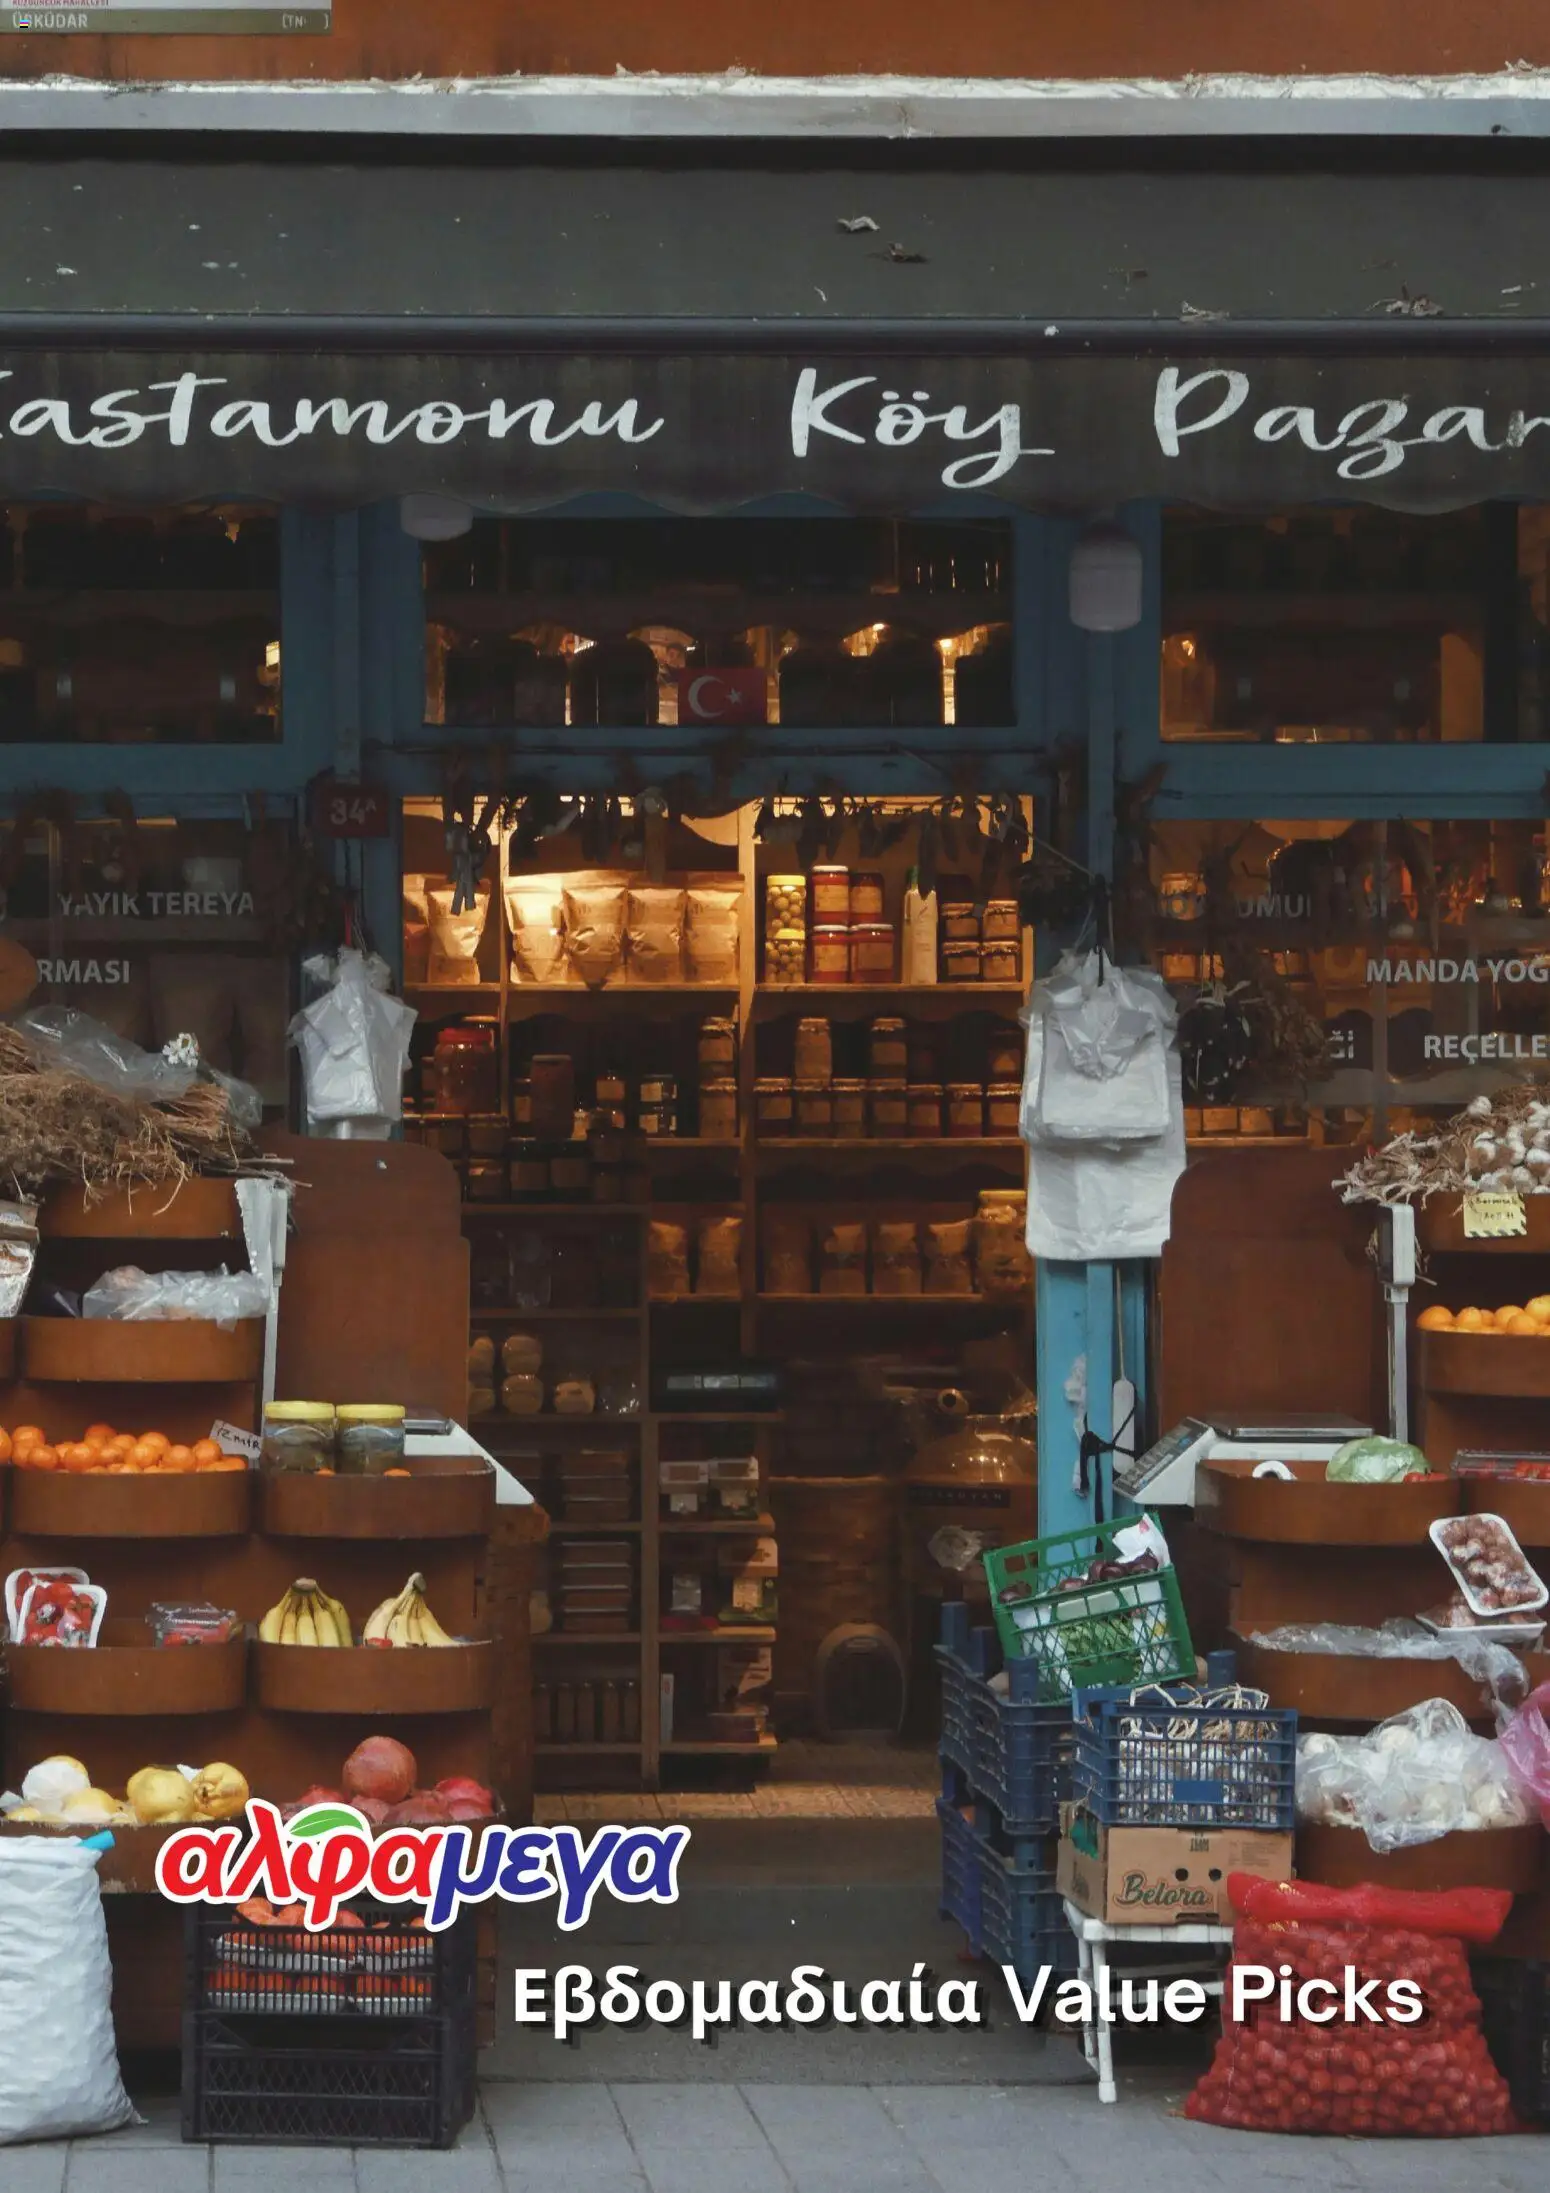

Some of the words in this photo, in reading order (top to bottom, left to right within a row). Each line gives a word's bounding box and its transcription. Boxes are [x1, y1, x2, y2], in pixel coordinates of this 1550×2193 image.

[0, 369, 665, 448] astamonu
[791, 367, 1055, 488] Köy
[58, 892, 140, 916] YAYIK
[1366, 958, 1480, 982] MANDA
[1424, 1034, 1548, 1065] REÇELLE
[1115, 1873, 1206, 1905] Belora
